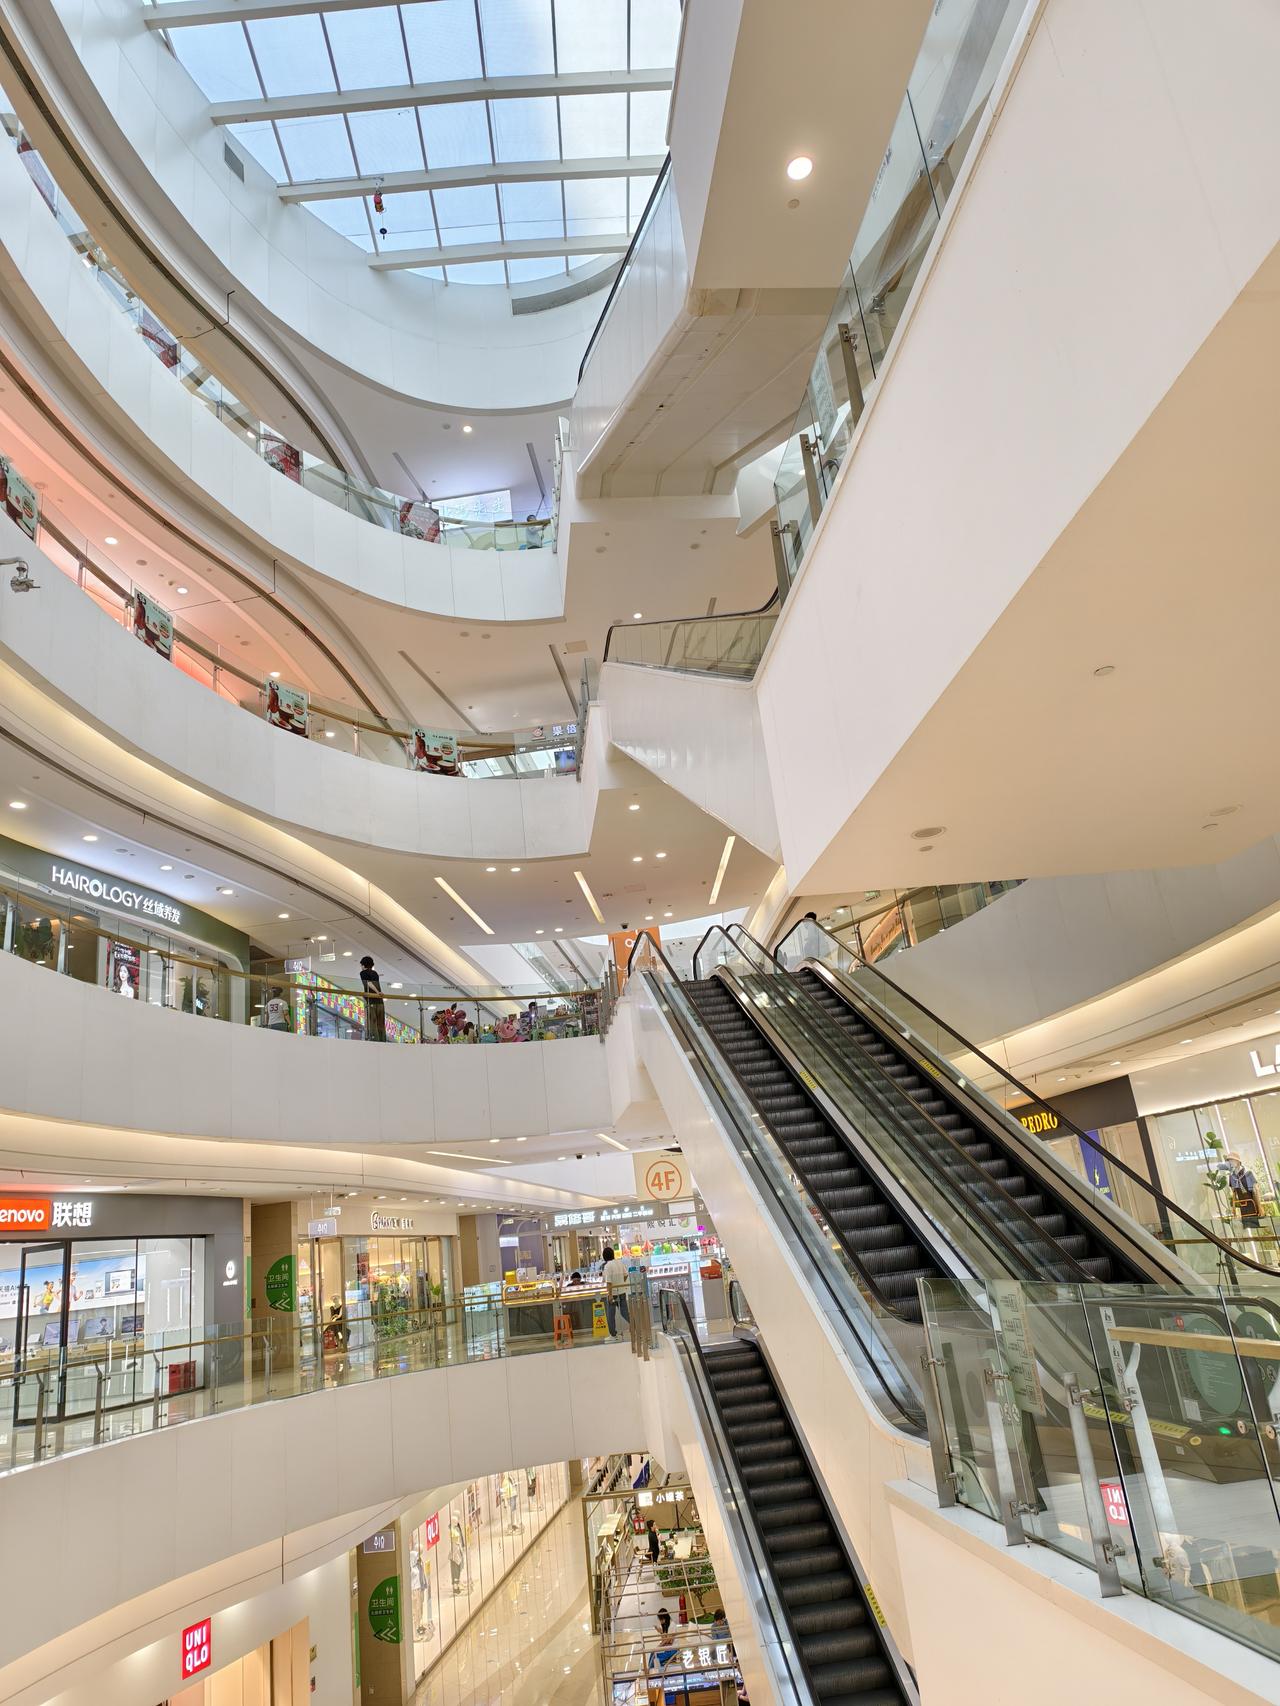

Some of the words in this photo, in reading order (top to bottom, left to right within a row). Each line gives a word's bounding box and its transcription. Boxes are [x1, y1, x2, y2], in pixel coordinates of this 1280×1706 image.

[52, 865, 143, 909] HAIROLOGY
[142, 900, 181, 925] 丝域养发
[651, 1170, 675, 1192] 4F
[51, 1202, 92, 1228] 联想
[185, 1625, 208, 1650] UNI
[185, 1646, 209, 1673] QLO
